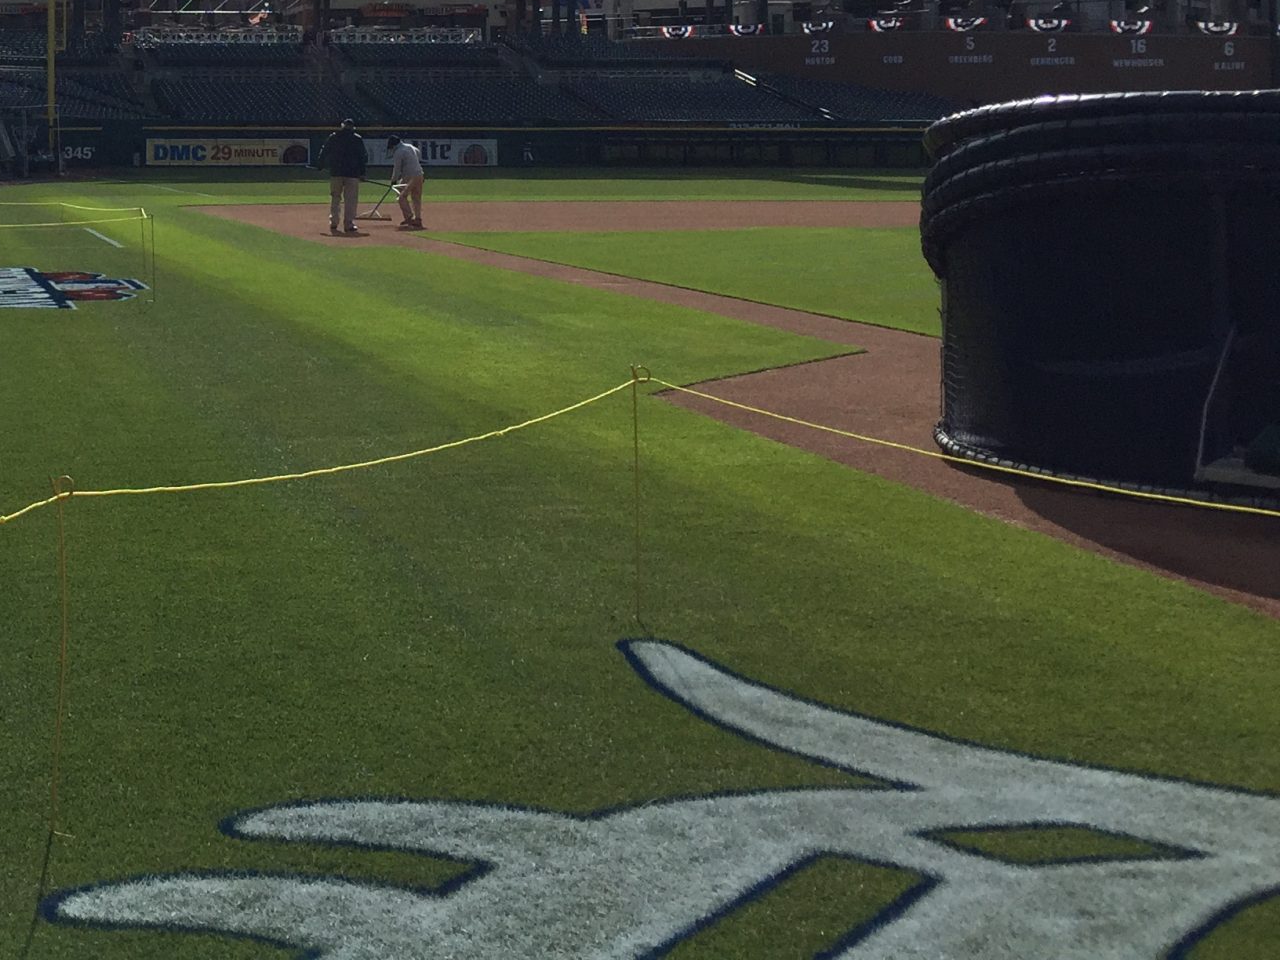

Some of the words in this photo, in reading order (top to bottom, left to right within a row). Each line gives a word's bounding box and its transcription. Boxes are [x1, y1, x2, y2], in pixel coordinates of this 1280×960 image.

[811, 39, 829, 53] 23
[965, 36, 976, 50] 5
[1047, 38, 1057, 52] 2
[1130, 39, 1147, 54] 16
[1223, 41, 1235, 56] 6
[153, 143, 207, 161] DMC
[210, 145, 232, 161] 29
[234, 148, 278, 158] MINUTE
[412, 139, 452, 161] ite
